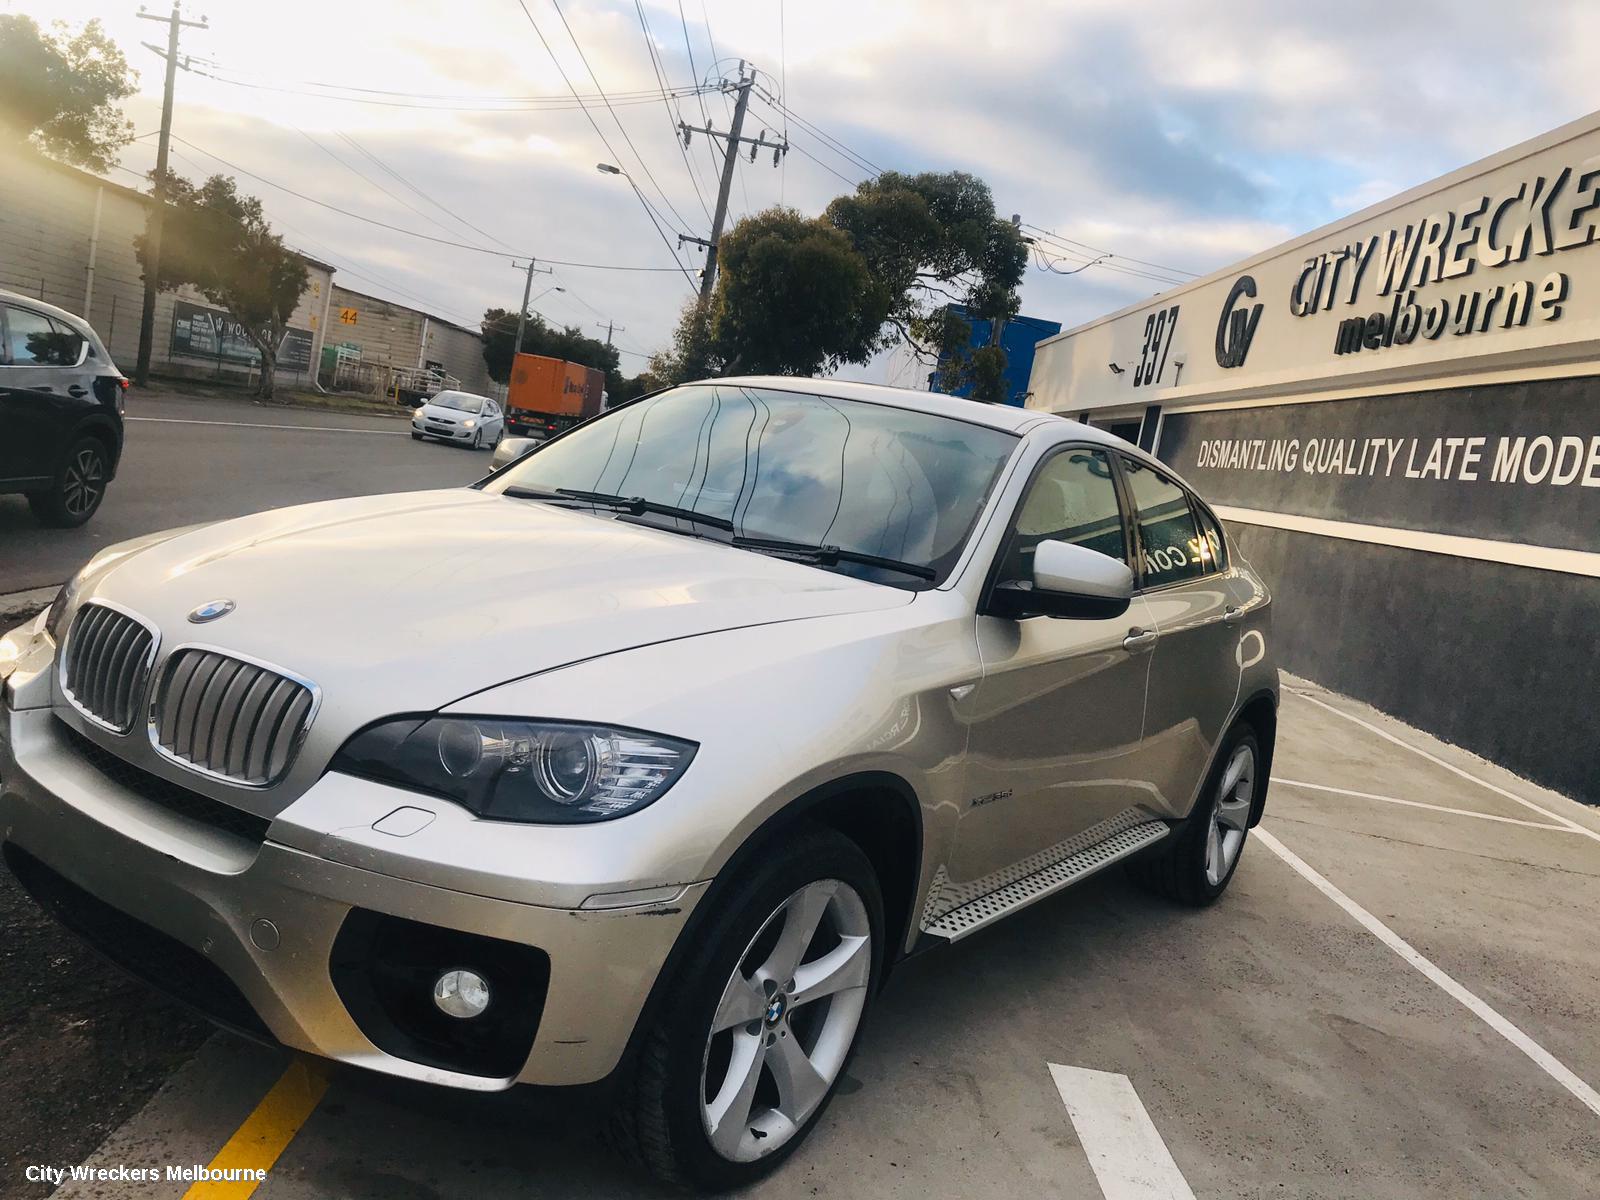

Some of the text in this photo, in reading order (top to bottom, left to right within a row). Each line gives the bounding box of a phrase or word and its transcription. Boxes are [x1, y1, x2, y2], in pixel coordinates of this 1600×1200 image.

[1290, 167, 1600, 317] CITY WRECKE
[340, 310, 358, 325] 44
[1133, 305, 1180, 388] 397
[1334, 272, 1568, 355] melbourne
[1197, 435, 1600, 488] DISMANTLING QUALITY LATE MODE
